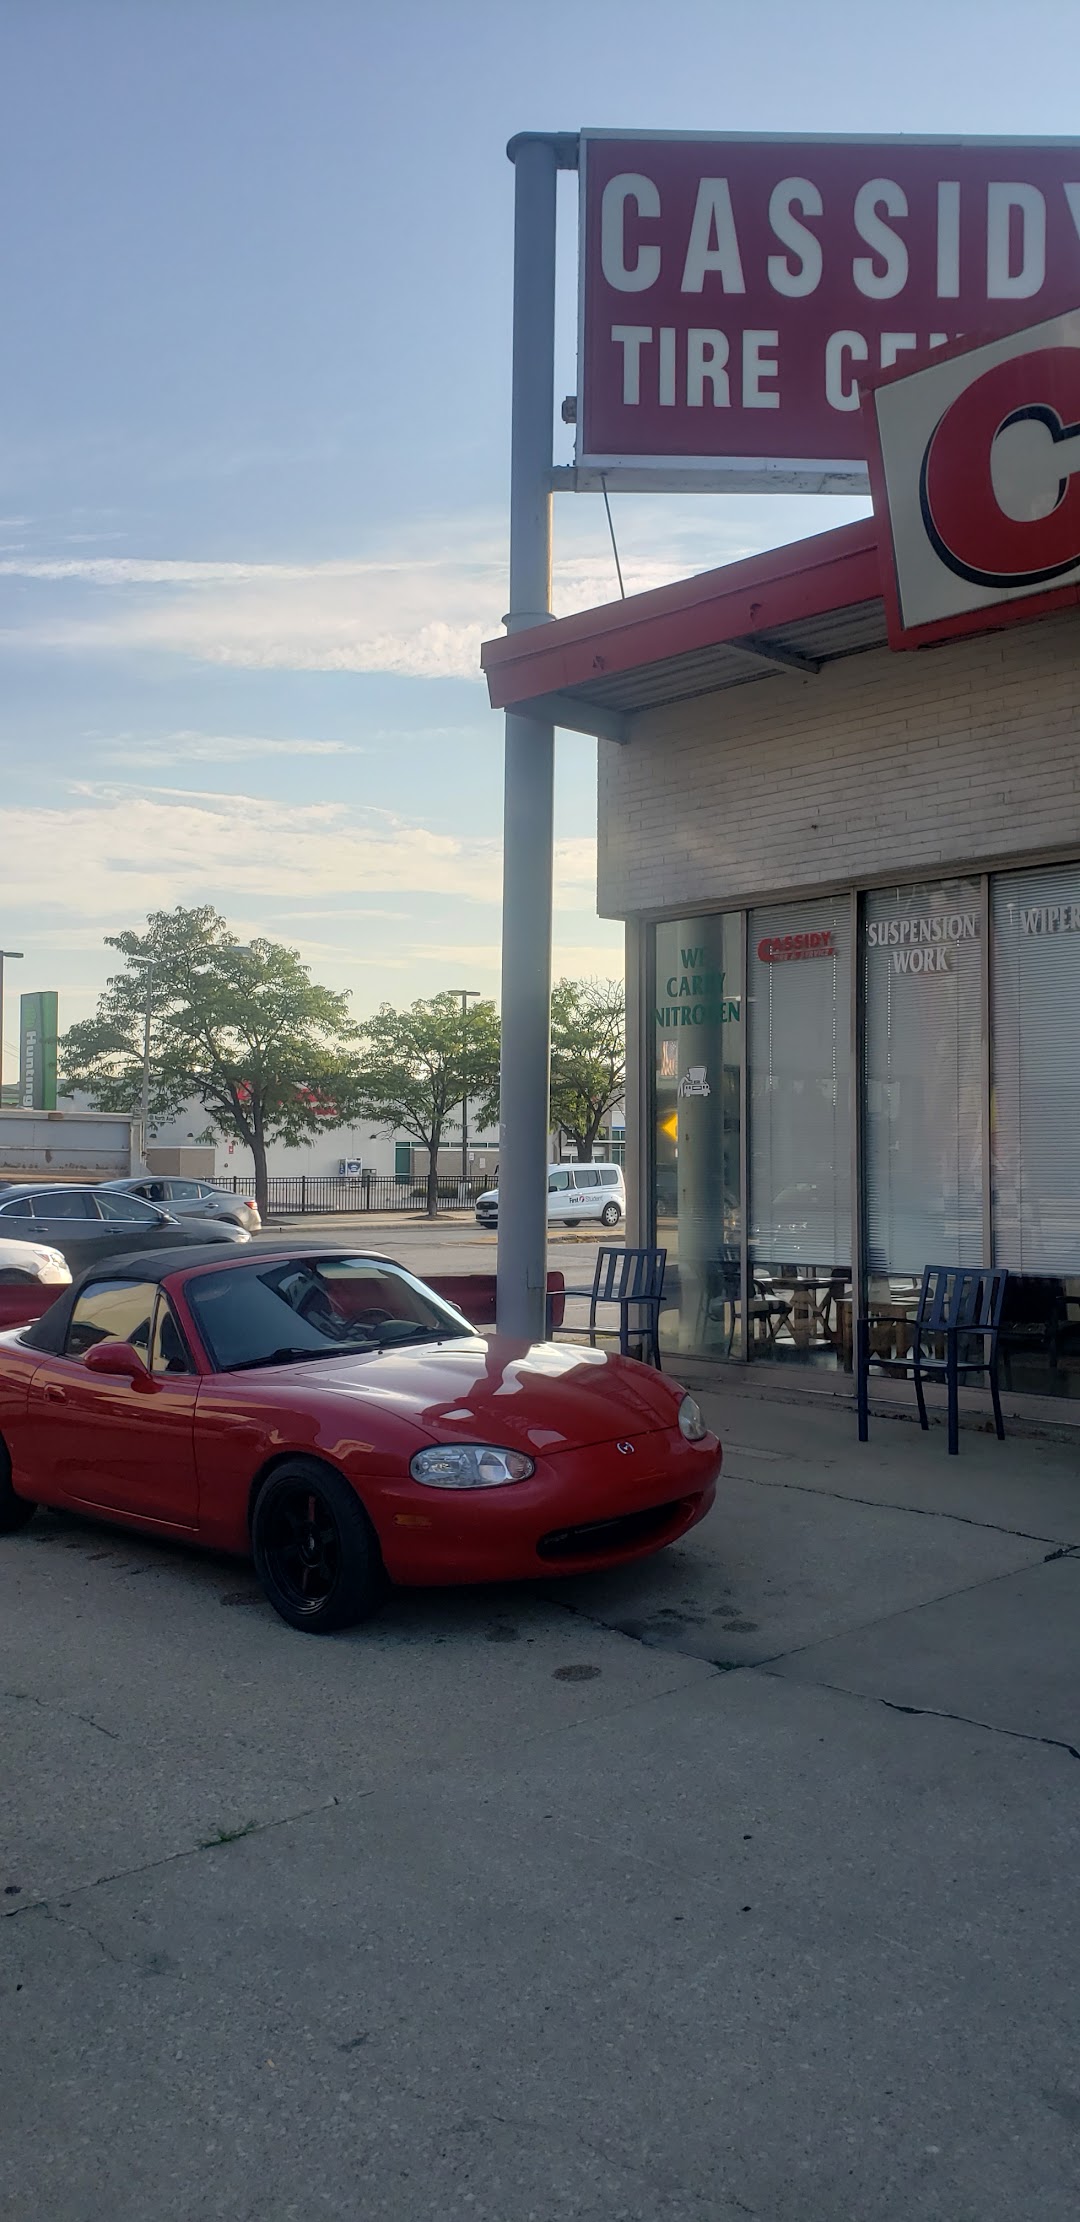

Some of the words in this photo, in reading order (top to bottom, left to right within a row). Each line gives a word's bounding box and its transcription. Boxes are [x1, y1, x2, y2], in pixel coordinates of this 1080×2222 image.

[601, 173, 1080, 300] CASSID
[611, 325, 781, 409] TIRE
[868, 914, 976, 947] SUSPENSION
[757, 931, 831, 962] CASSIDY
[893, 948, 948, 974] WORK
[666, 973, 726, 998] CARY
[654, 1001, 740, 1028] NITROEN
